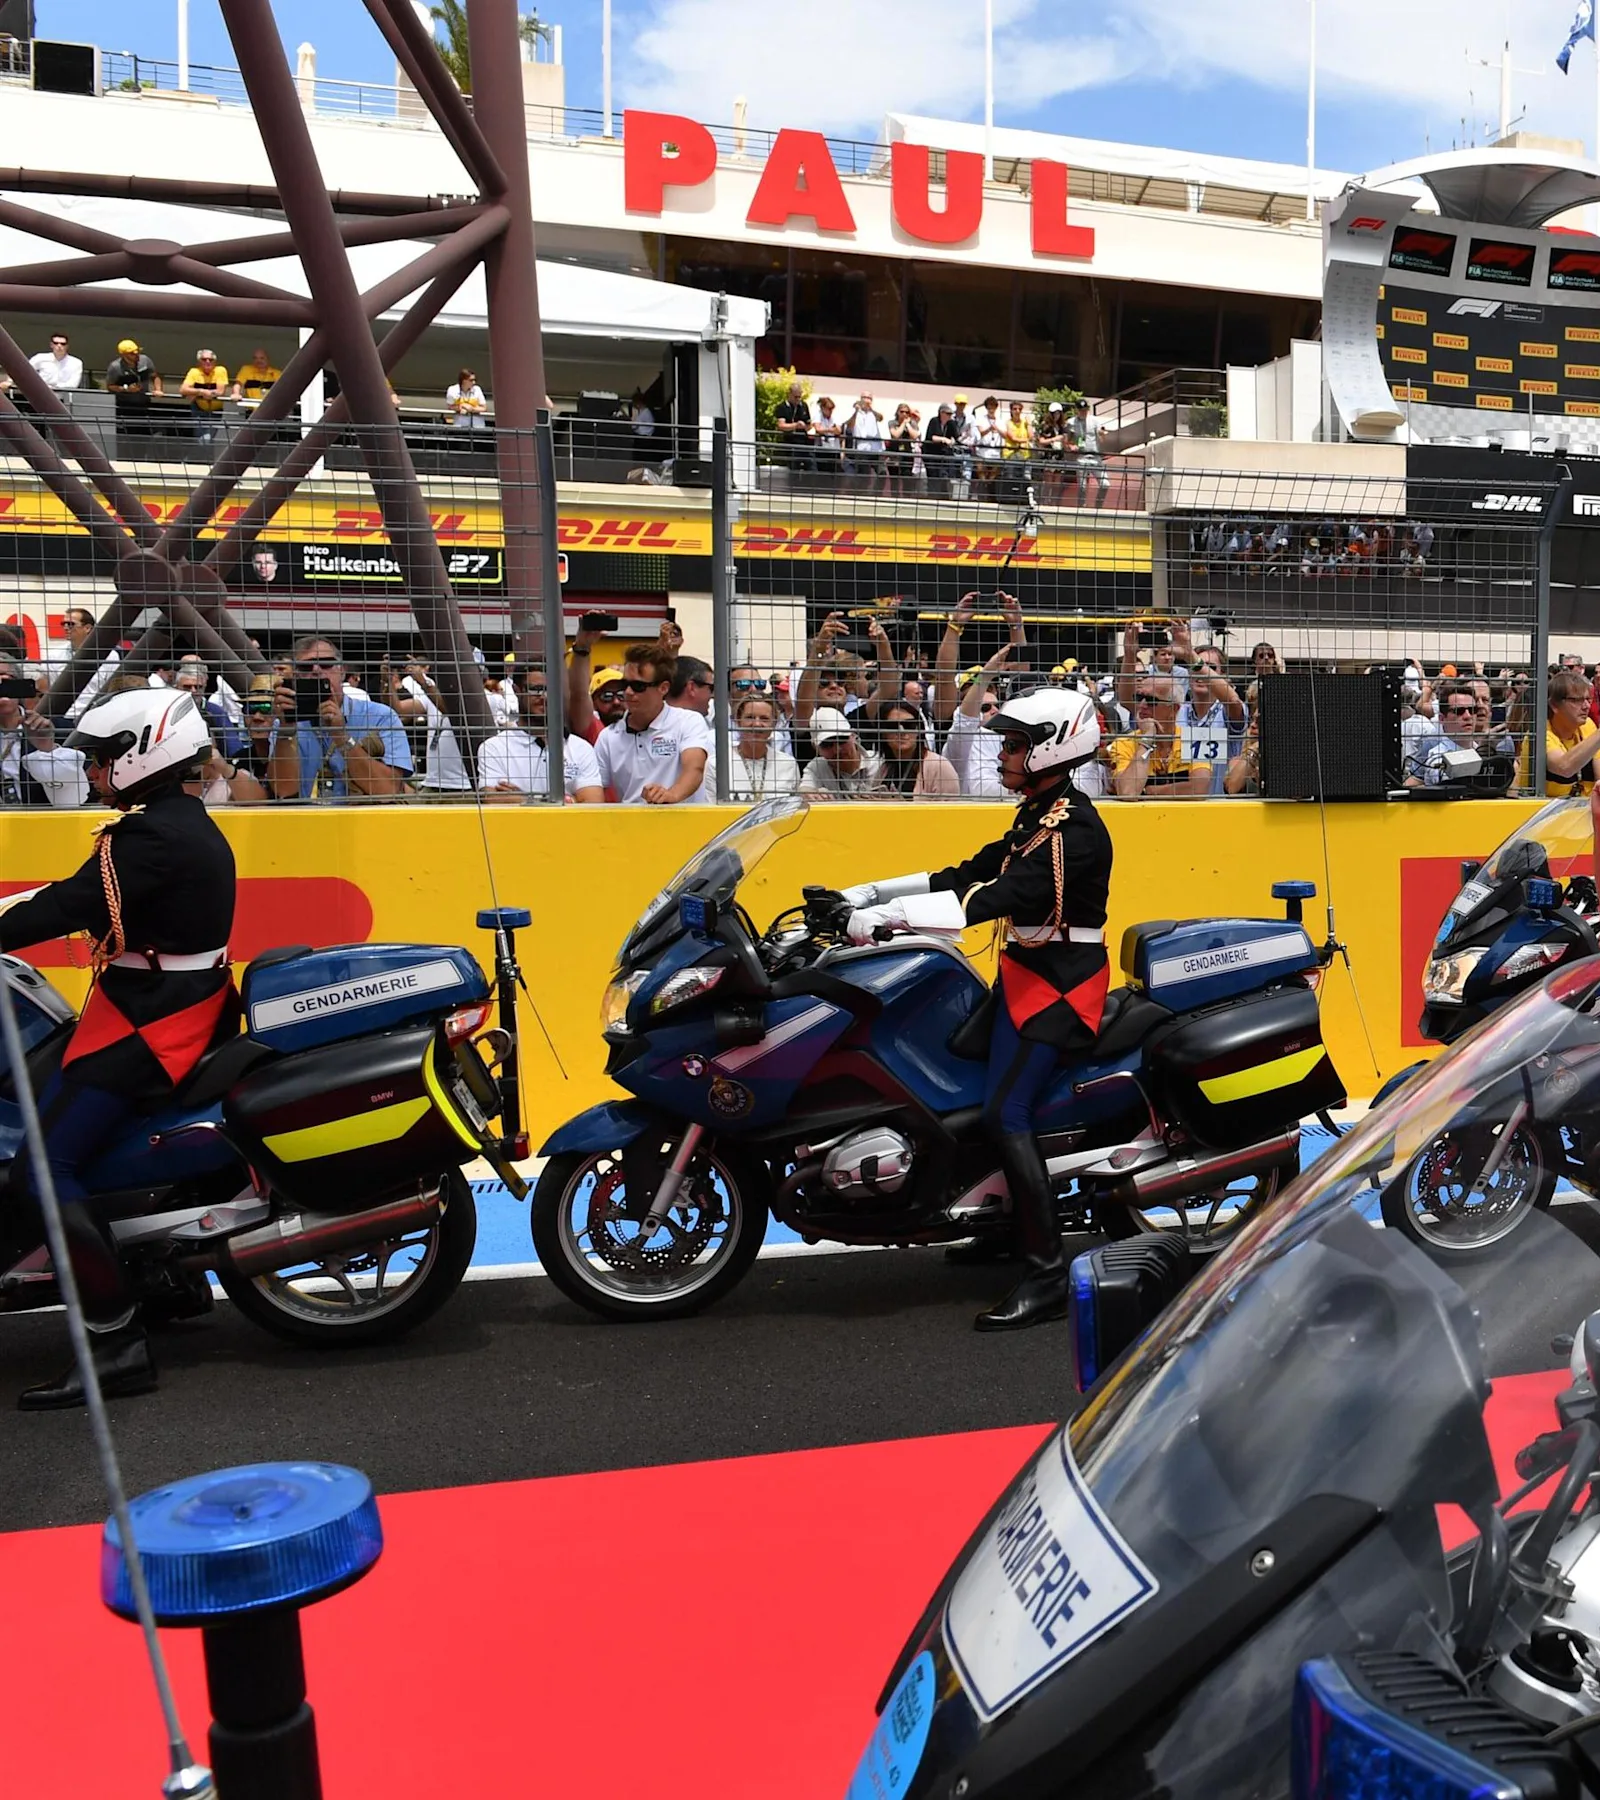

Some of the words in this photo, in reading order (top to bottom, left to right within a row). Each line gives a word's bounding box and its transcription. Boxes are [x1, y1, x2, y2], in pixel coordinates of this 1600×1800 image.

[624, 110, 1095, 258] PAUL
[1394, 311, 1424, 322] PIRELLI
[1568, 331, 1600, 341] PIRELLI
[1436, 337, 1466, 348] PIRELLI
[1394, 350, 1424, 362] PIRELLI
[1523, 345, 1555, 356] PIRELLI
[1479, 360, 1509, 371] PIRELLI
[1568, 367, 1600, 377] PIRELLI
[1436, 375, 1466, 386] PIRELLI
[1479, 398, 1509, 408] PIRELLI
[1568, 405, 1599, 415] PIRELLI
[1482, 494, 1542, 512] DHL
[741, 526, 869, 555] DHL
[303, 545, 329, 555] Nico
[928, 534, 1042, 563] DHL
[304, 556, 400, 573] Hulkenb
[449, 554, 490, 573] 27
[1190, 740, 1219, 760] 13
[1183, 948, 1249, 973] GENDARMERIE
[293, 974, 418, 1015] GENDARMERIE
[370, 1090, 394, 1103] BMW
